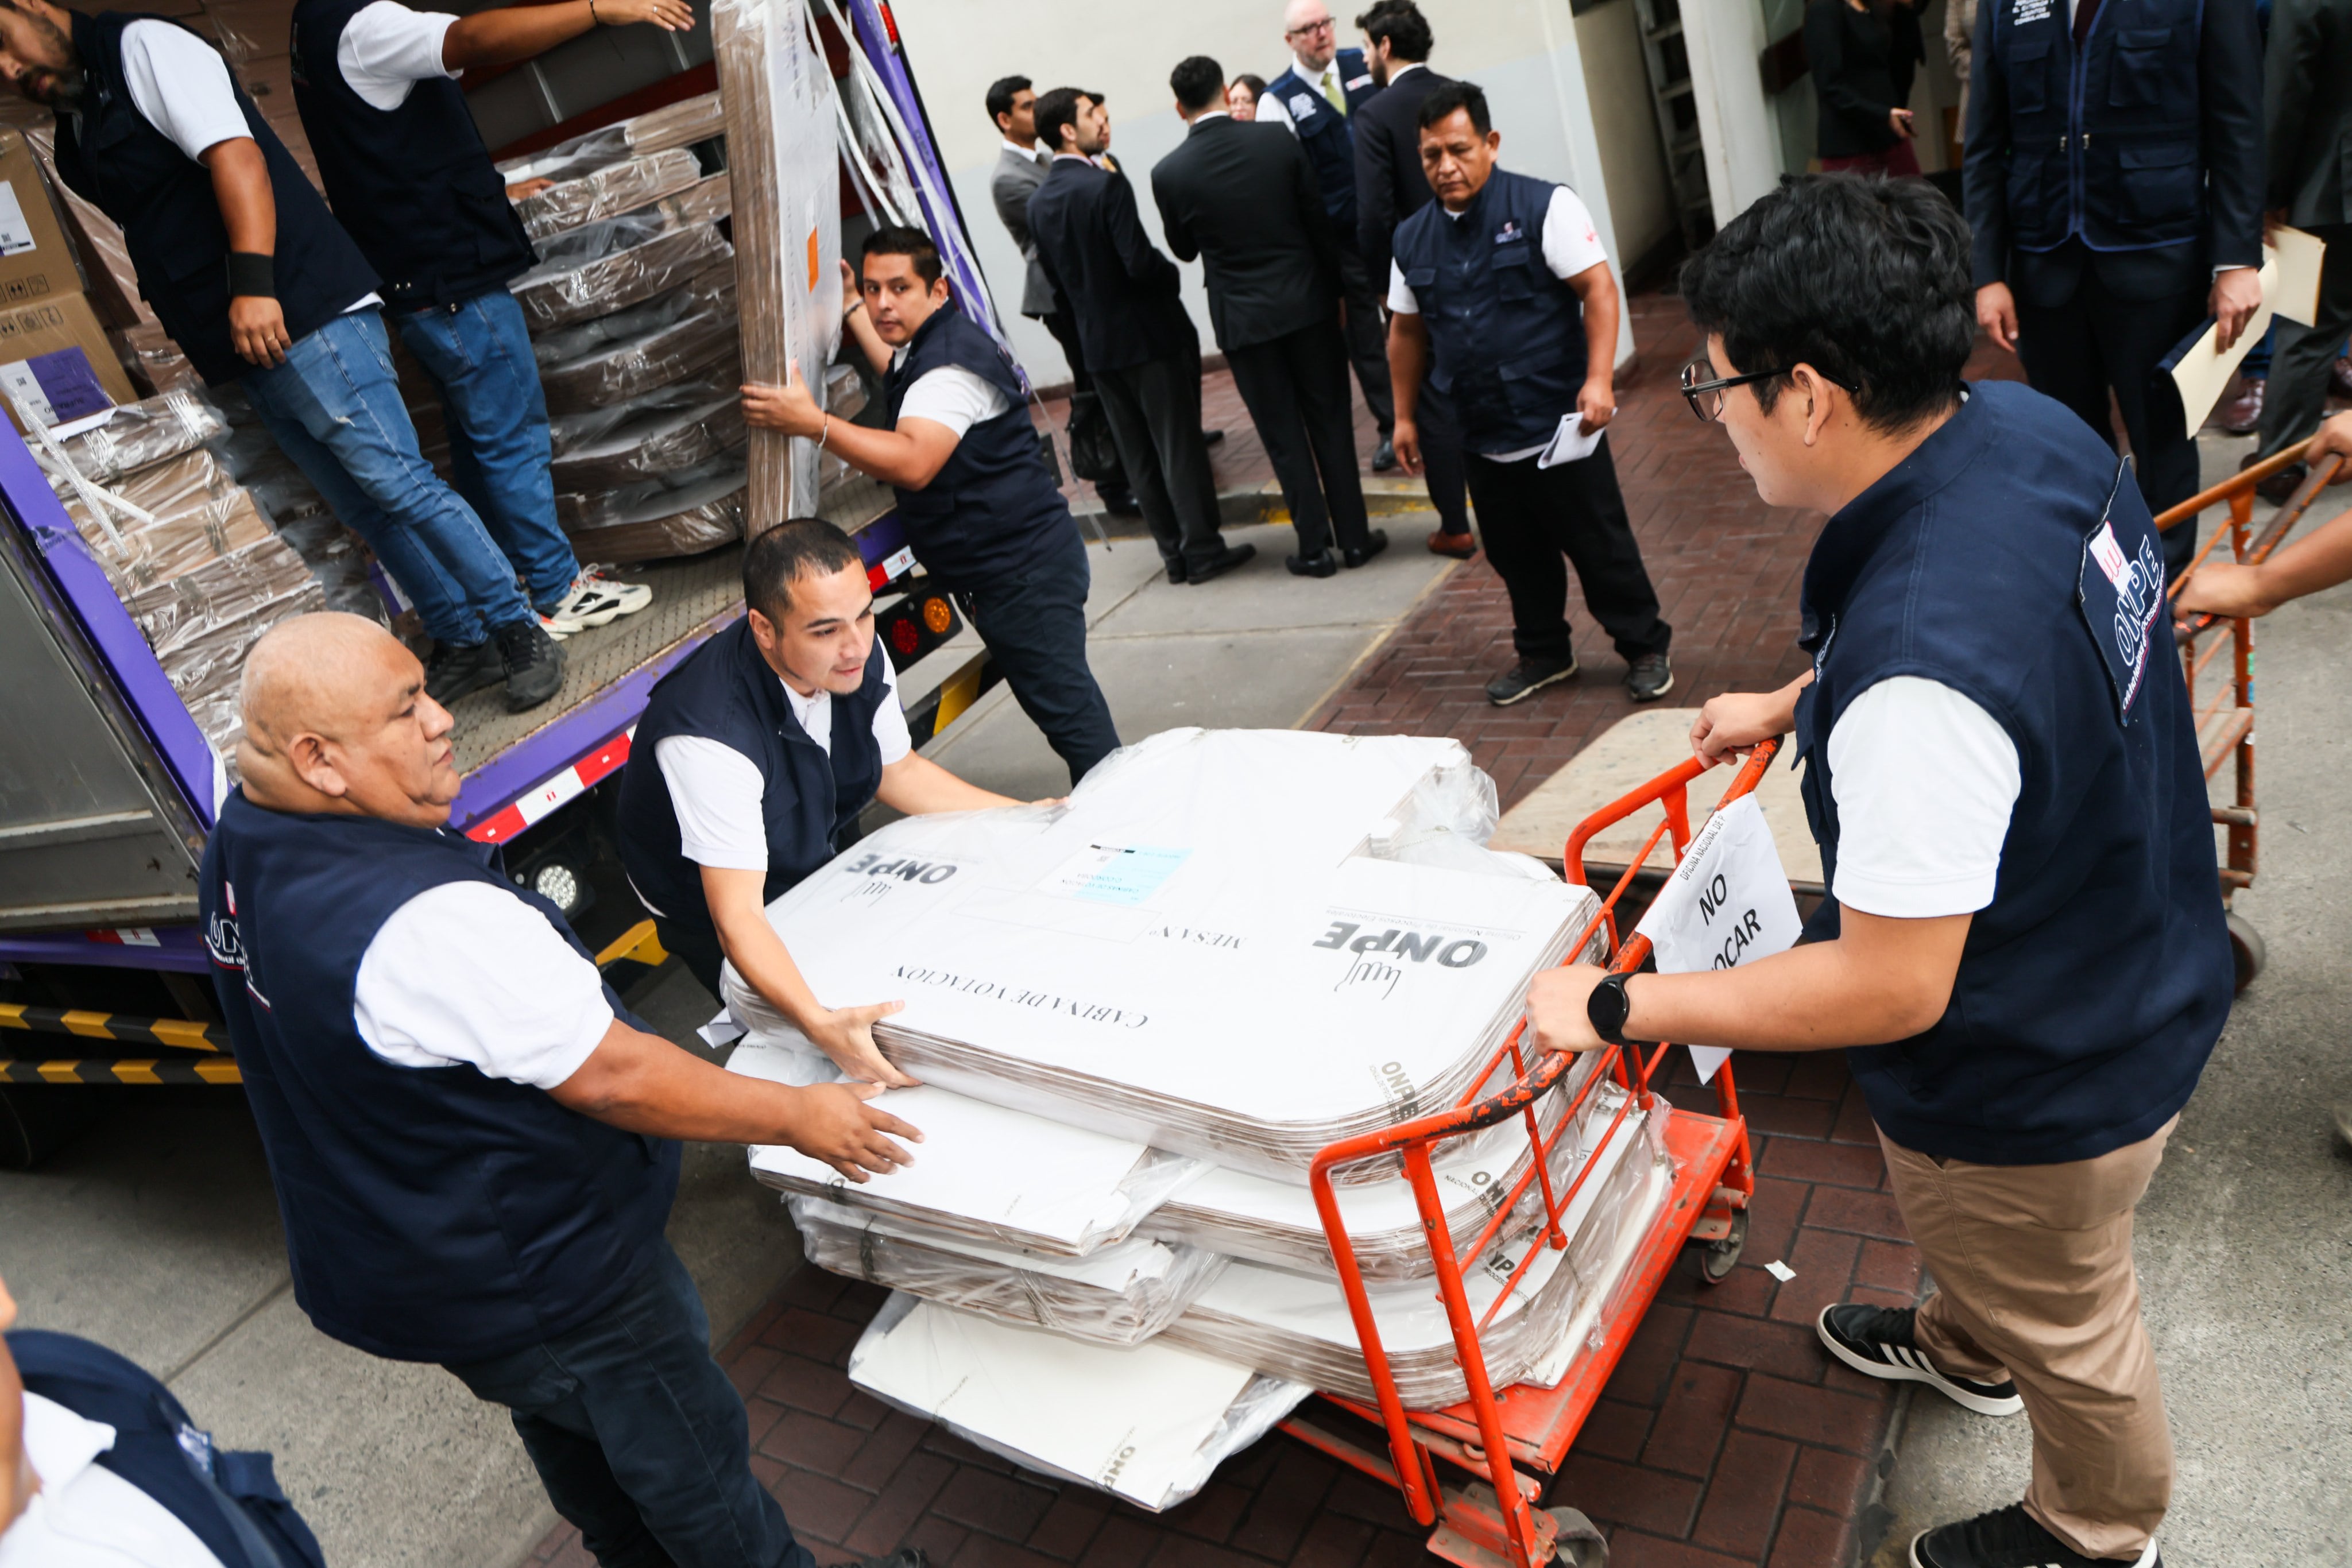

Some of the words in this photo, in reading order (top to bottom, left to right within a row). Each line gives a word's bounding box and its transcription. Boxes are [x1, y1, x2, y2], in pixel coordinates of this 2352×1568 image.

[2114, 533, 2159, 667] ONPE
[845, 853, 958, 884] ONPE
[1680, 856, 1700, 881] OFICINA
[1695, 828, 1718, 858] NACIONAL
[1715, 818, 1724, 830] DE
[1699, 874, 1727, 927] NO
[1181, 928, 1247, 949] MESA
[1312, 920, 1488, 968] ONPE
[1441, 926, 1483, 937] Nacional
[1712, 908, 1761, 971] OCAR
[1011, 989, 1047, 1008] DE
[1051, 997, 1148, 1028] CABINA
